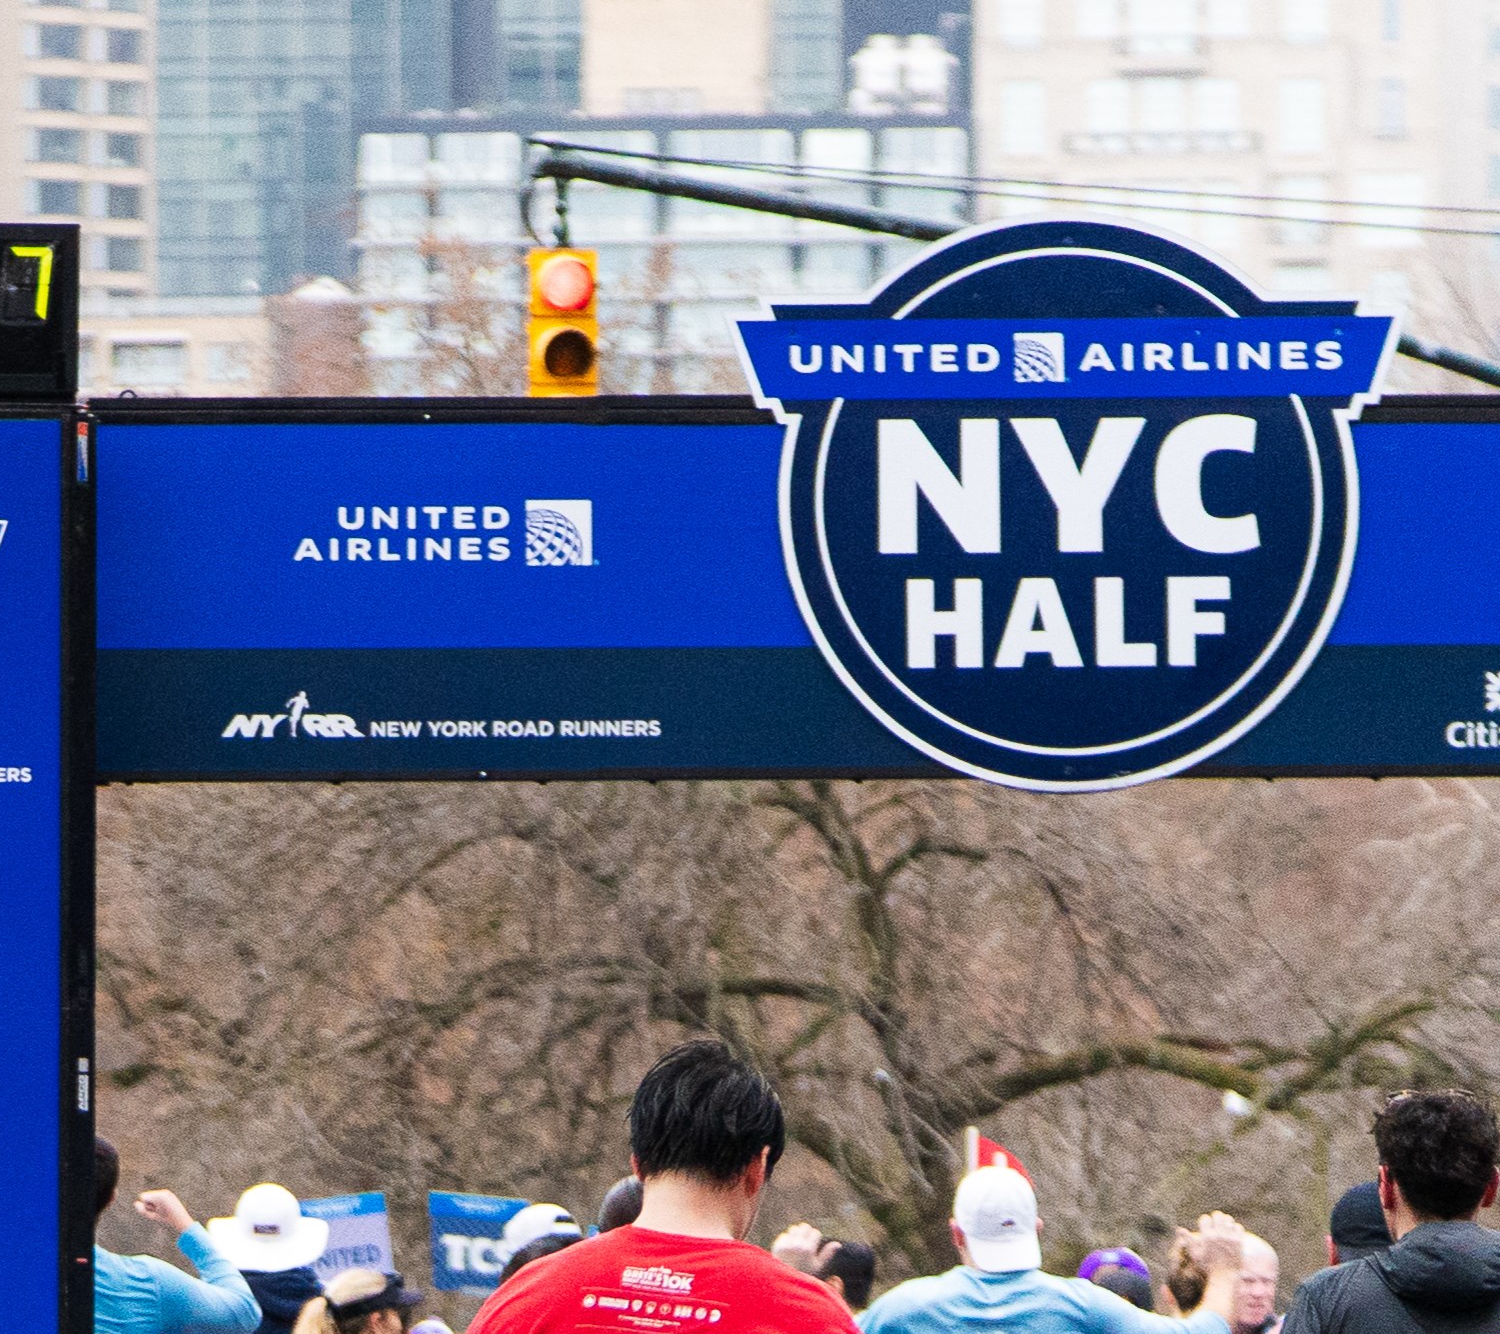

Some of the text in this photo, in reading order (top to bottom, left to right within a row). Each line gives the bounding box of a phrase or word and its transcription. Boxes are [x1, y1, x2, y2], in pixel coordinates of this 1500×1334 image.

[790, 341, 1342, 373] UNITED AIRLINES
[878, 414, 1260, 554] NYC
[338, 507, 509, 530] UNITED
[294, 537, 510, 561] AIRLINES
[906, 576, 1230, 668] HALF
[221, 702, 661, 738] NYRR NEW YORK ROAD RUNNERS
[439, 1233, 512, 1274] TC
